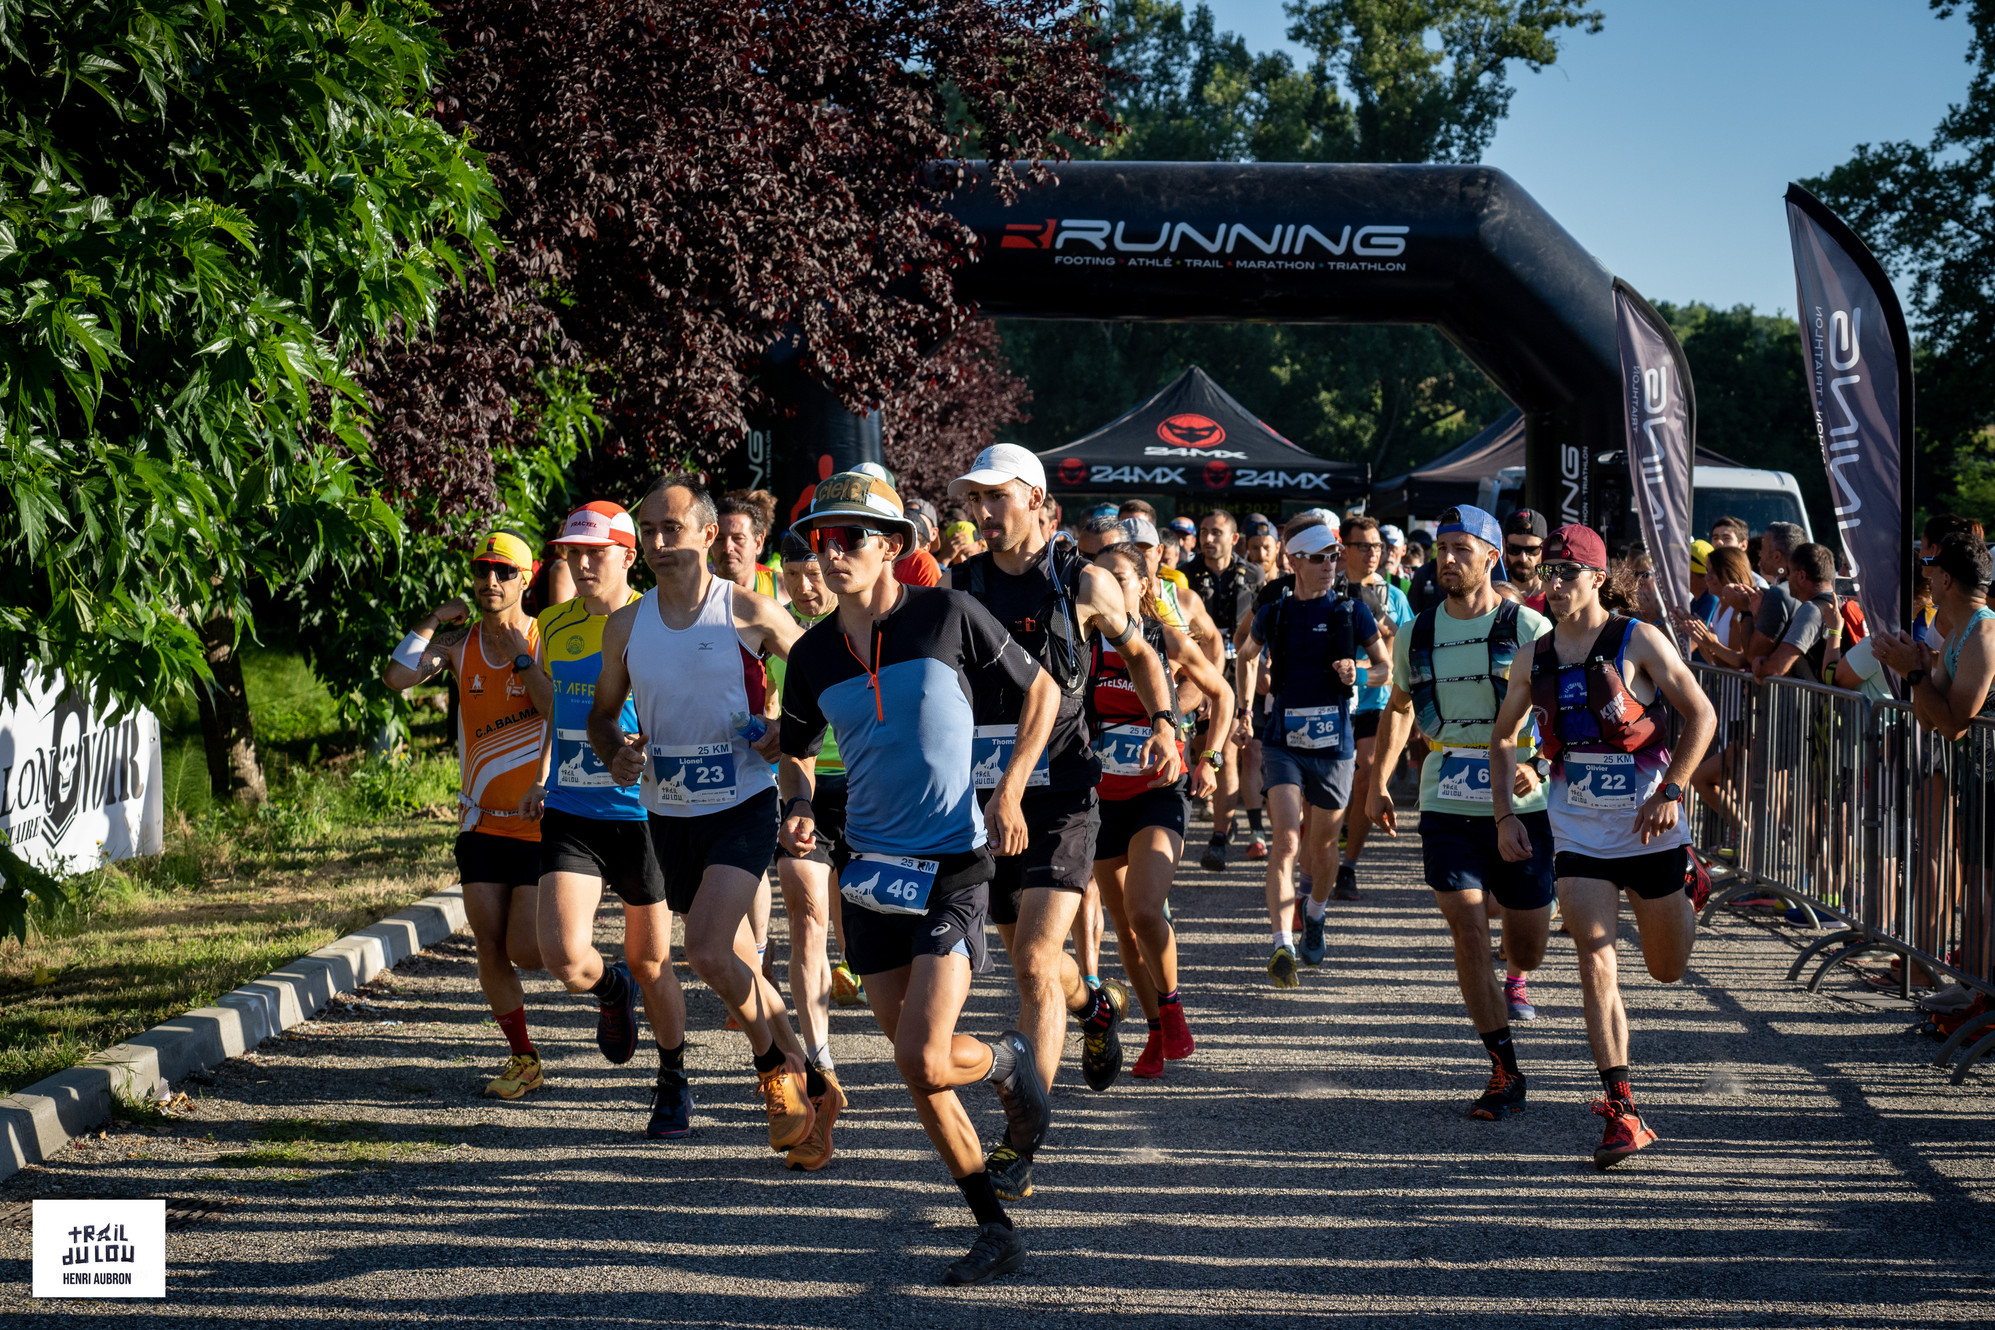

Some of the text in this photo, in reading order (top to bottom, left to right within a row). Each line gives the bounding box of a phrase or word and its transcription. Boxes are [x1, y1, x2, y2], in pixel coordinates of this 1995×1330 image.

[1055, 219, 1410, 256] RUNNING
[1055, 255, 1406, 271] FOOTING ATHLÉ TRAIL MARATHON TRIATHLON
[1143, 446, 1249, 460] 24MX
[1090, 465, 1187, 485] 24MX
[1234, 469, 1331, 491] 24MX
[818, 478, 862, 503] ciele
[1244, 503, 1280, 514] 2022
[475, 706, 539, 739] C.A.BALMA
[1316, 721, 1334, 734] 36
[1129, 726, 1140, 735] 25
[653, 744, 729, 756] M 25 KM
[679, 757, 703, 765] Lionel
[1603, 755, 1614, 764] 25
[1616, 755, 1632, 763] KM
[695, 765, 724, 783] 23
[1477, 768, 1490, 783] 6
[1585, 764, 1609, 772] Olivier
[1601, 774, 1626, 790] 22
[900, 858, 914, 867] 25
[886, 878, 919, 901] 46
